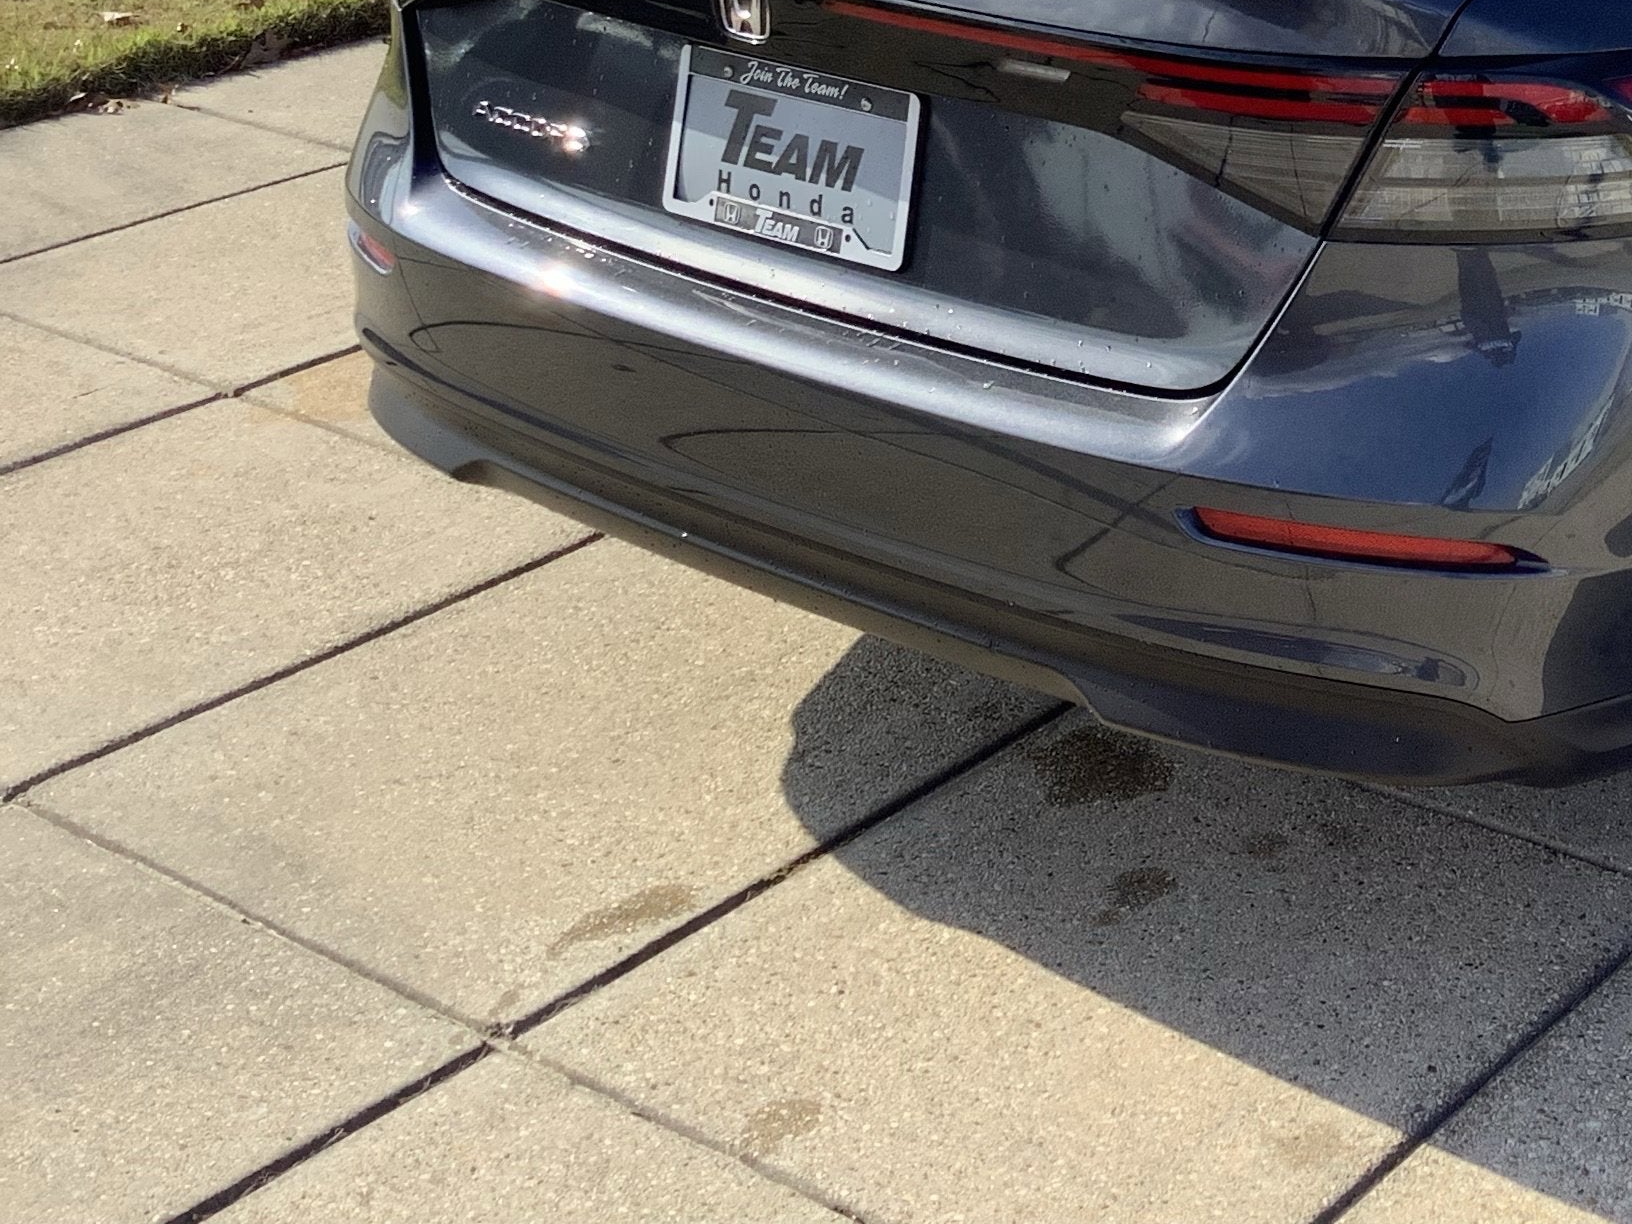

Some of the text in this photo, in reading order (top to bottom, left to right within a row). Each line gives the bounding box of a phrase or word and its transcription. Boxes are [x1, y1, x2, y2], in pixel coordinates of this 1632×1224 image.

[739, 60, 850, 100] Join The Team!
[720, 88, 866, 193] TEAM
[716, 168, 855, 225] Honda
[754, 206, 800, 252] TEAM
